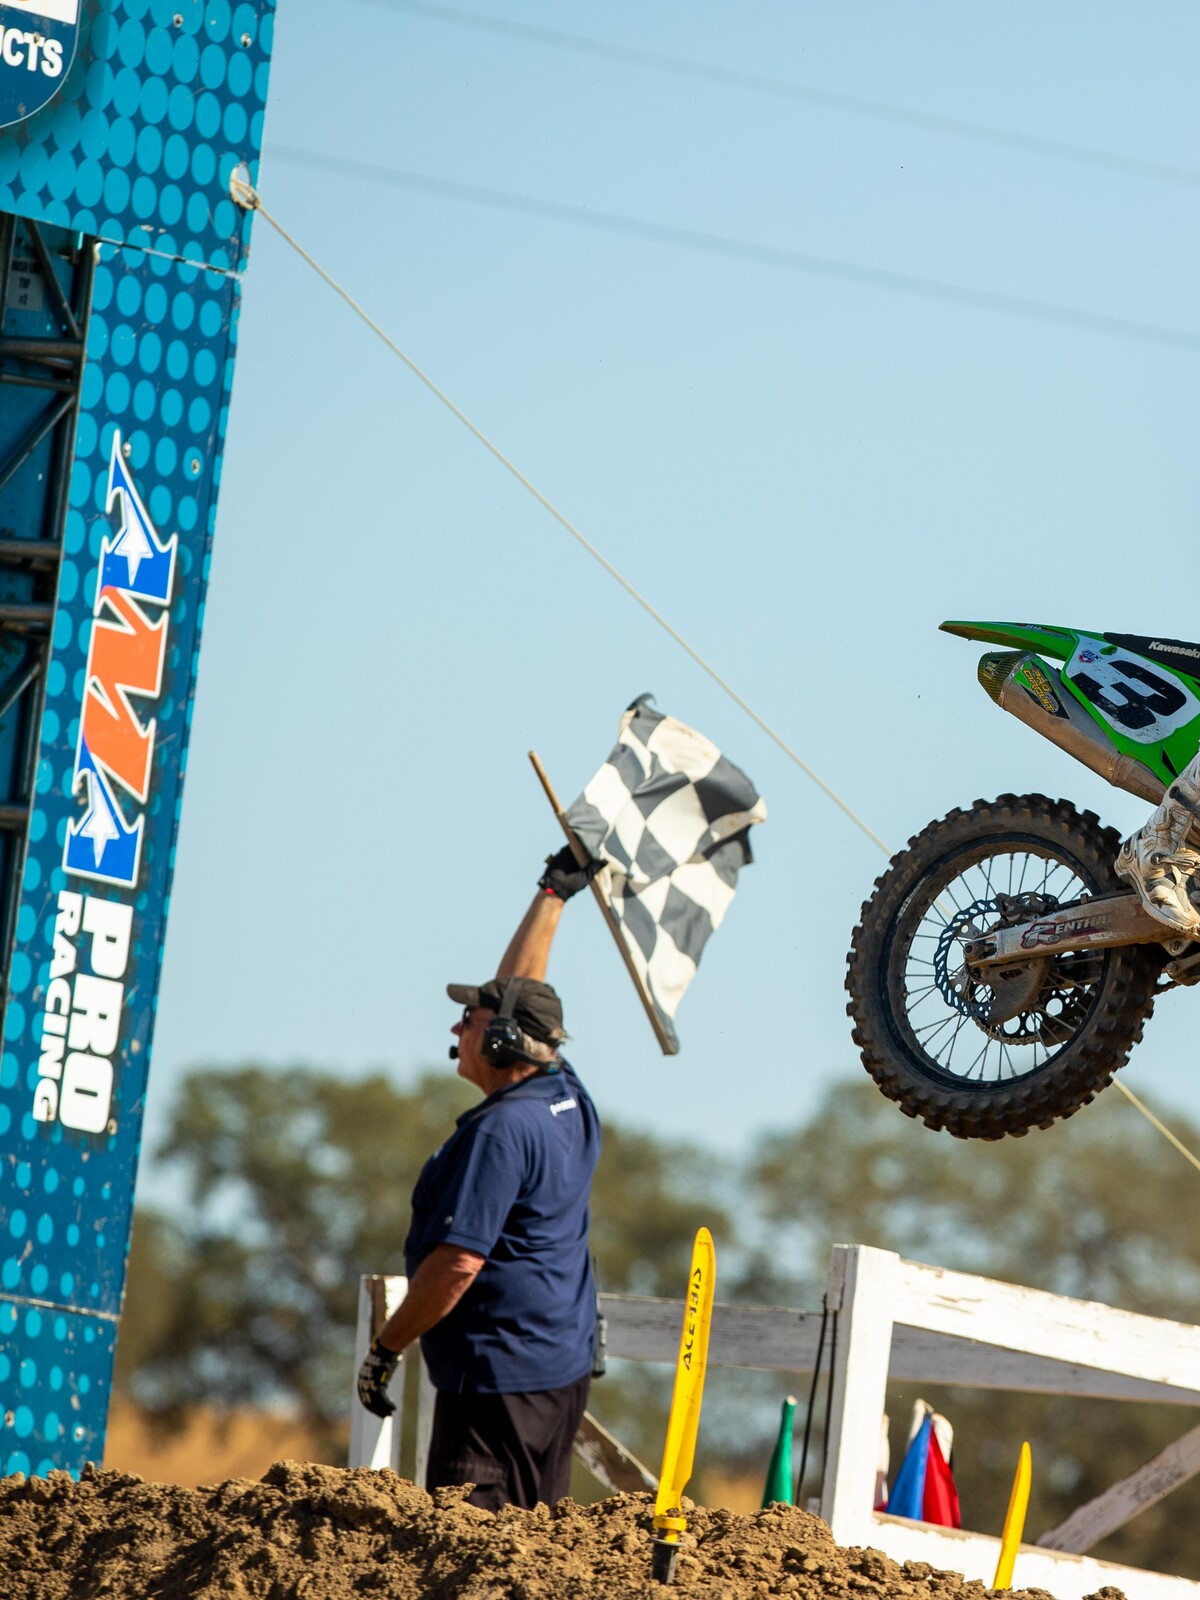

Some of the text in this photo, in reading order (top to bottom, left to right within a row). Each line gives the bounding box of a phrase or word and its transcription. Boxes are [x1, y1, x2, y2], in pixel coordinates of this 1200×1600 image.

[0, 27, 64, 77] CTS
[1022, 669, 1056, 713] CIRCUIT
[1070, 660, 1187, 729] 3
[32, 889, 83, 1122] RACING
[59, 895, 134, 1133] PRO
